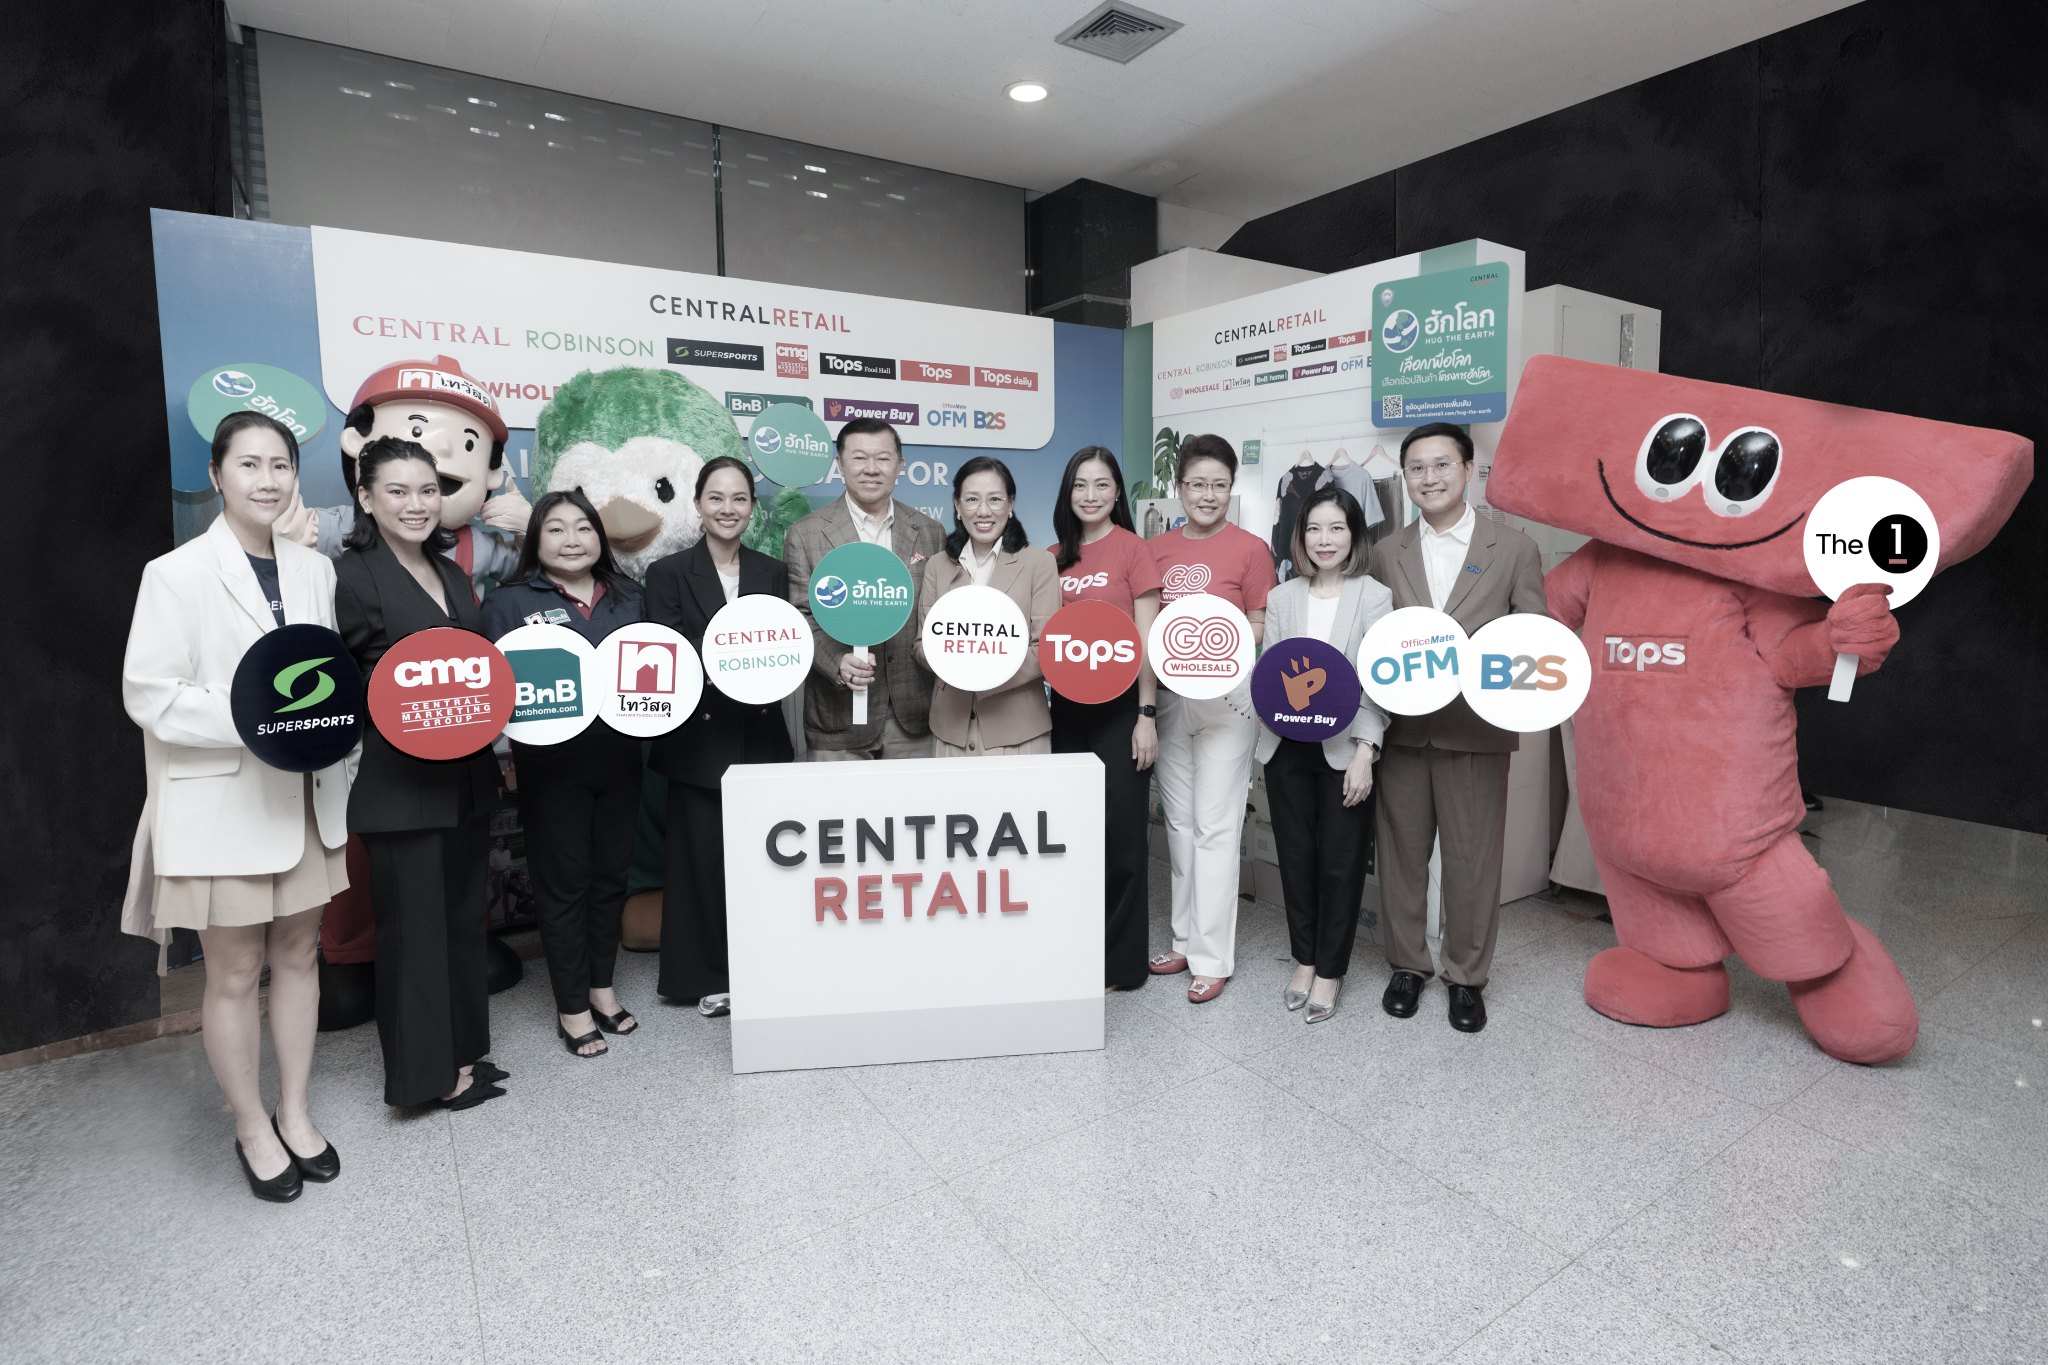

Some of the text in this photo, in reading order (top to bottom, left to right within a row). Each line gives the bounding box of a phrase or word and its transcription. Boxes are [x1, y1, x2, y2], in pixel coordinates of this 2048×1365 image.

[1425, 301, 1495, 335] ฮักโลก
[1425, 330, 1495, 345] HUG THE EARTH
[352, 315, 510, 347] CENTRAL
[526, 329, 654, 357] ROBINSON
[694, 349, 758, 362] SUPERSPORTS
[777, 346, 808, 361] cmg
[825, 355, 863, 373] Tops
[919, 364, 953, 381] Tops
[981, 369, 1012, 386] Tops
[1013, 377, 1033, 388] daily
[1157, 366, 1192, 381] CENTRAL
[1196, 359, 1233, 373] ROBINSON
[1294, 343, 1311, 353] Tops
[1338, 334, 1356, 344] Tops
[1301, 367, 1322, 376] Power
[1322, 364, 1335, 373] Buy
[1341, 359, 1364, 371] OFM
[1184, 383, 1220, 395] WHOLESALE
[731, 398, 762, 412] BnB
[844, 405, 914, 424] Power Buy
[927, 409, 1007, 431] OFM B2S
[784, 433, 829, 453] ฮักโลก
[1816, 523, 1903, 555] The 1
[852, 578, 908, 599] ฮักโลก
[714, 628, 802, 646] CENTRAL
[931, 621, 1020, 638] CENTRAL
[1163, 616, 1240, 661] GO
[943, 639, 1009, 656] RETAIL
[1401, 634, 1456, 649] OfficeMate
[718, 653, 802, 672] ROBINSON
[1045, 634, 1136, 671] Tops
[1605, 636, 1687, 672] Tops
[394, 656, 491, 689] cmg
[1171, 663, 1232, 672] WHOLESALE
[1371, 646, 1460, 686] OFM
[1481, 654, 1568, 692] B2S
[514, 679, 578, 707] BnB
[402, 704, 491, 721] MARKETING
[412, 697, 481, 711] CENTRAL
[515, 705, 578, 718] bnbhome.com
[617, 694, 672, 718] ไทวัสดุ
[257, 714, 355, 736] SUPERSPORTS
[423, 715, 473, 727] GROUP
[1274, 712, 1338, 727] Power Buy
[765, 810, 1067, 867] CENTRAL
[813, 868, 1029, 922] RETAIL
